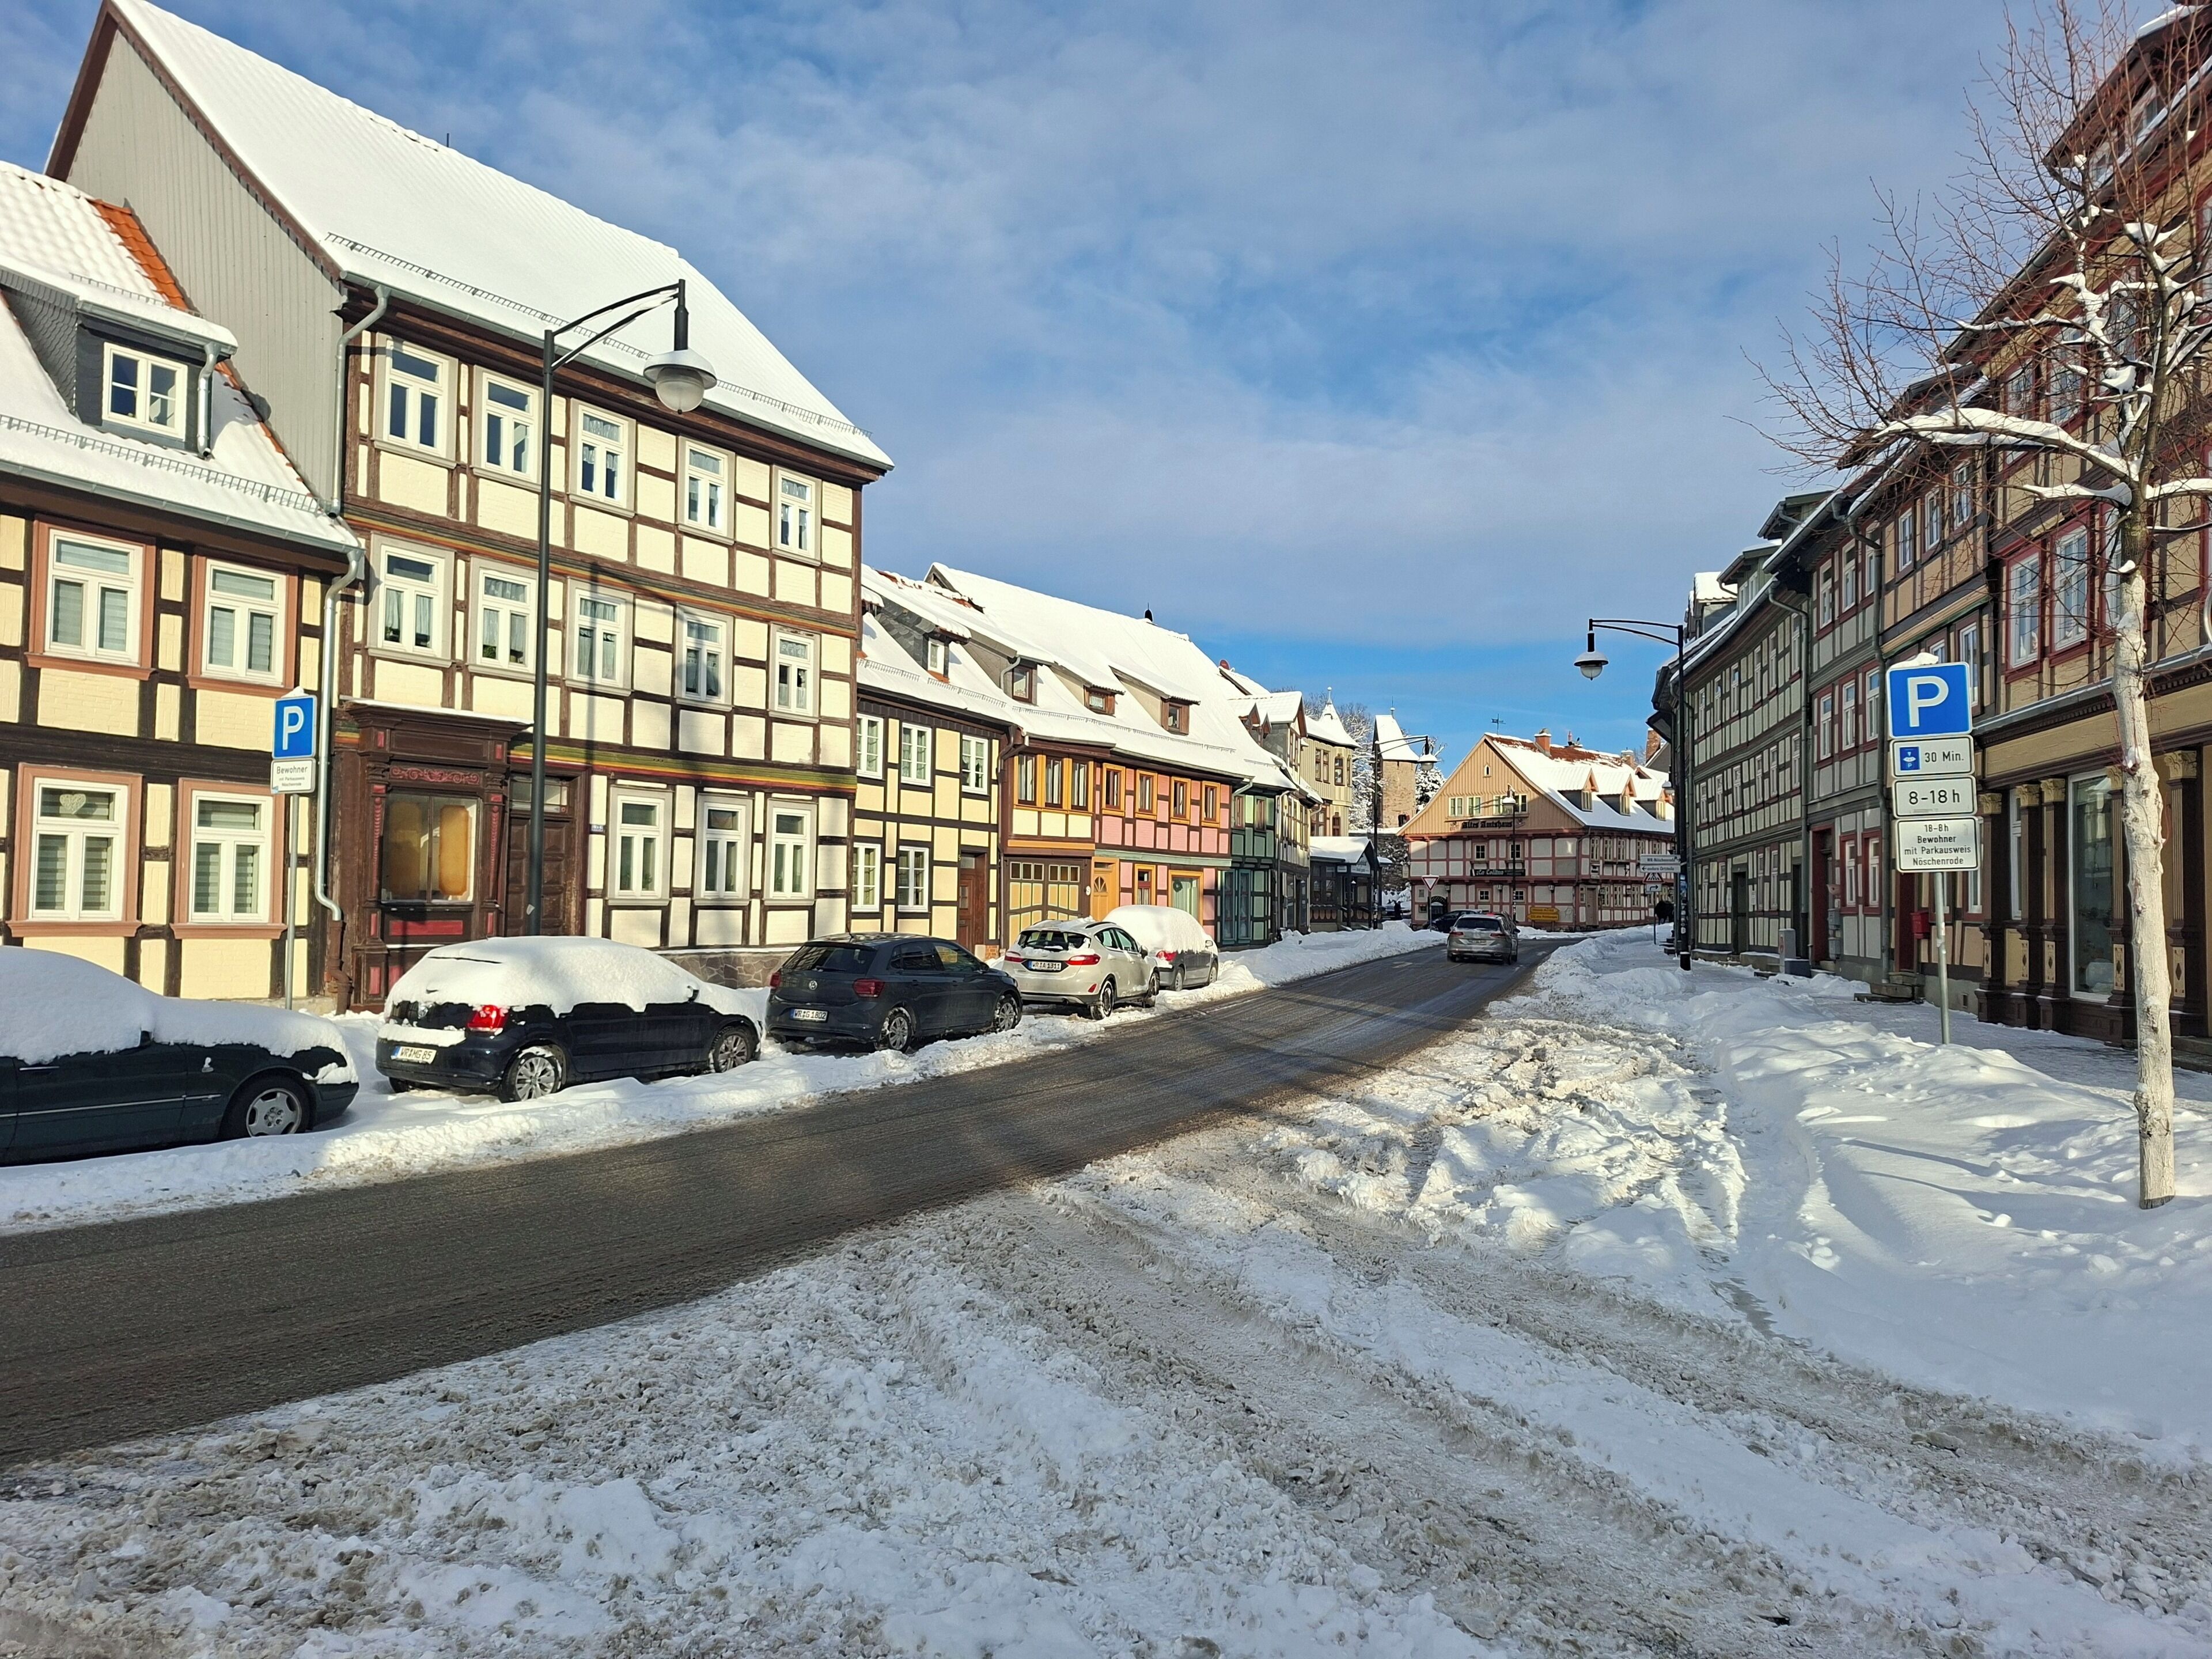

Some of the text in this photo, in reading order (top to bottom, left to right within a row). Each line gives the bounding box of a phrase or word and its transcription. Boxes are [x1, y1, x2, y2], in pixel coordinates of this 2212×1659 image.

[1907, 676, 1949, 728] P
[282, 706, 304, 751] P
[1925, 751, 1964, 763] 30 Min.
[276, 766, 308, 774] Bewohner
[1909, 789, 1960, 805] 8-18 h
[1480, 820, 1512, 829] Amtshaus
[1918, 835, 1957, 843] Bewohner
[1904, 845, 1971, 855] mit Parkausweis
[1913, 857, 1963, 866] Nöschenrode
